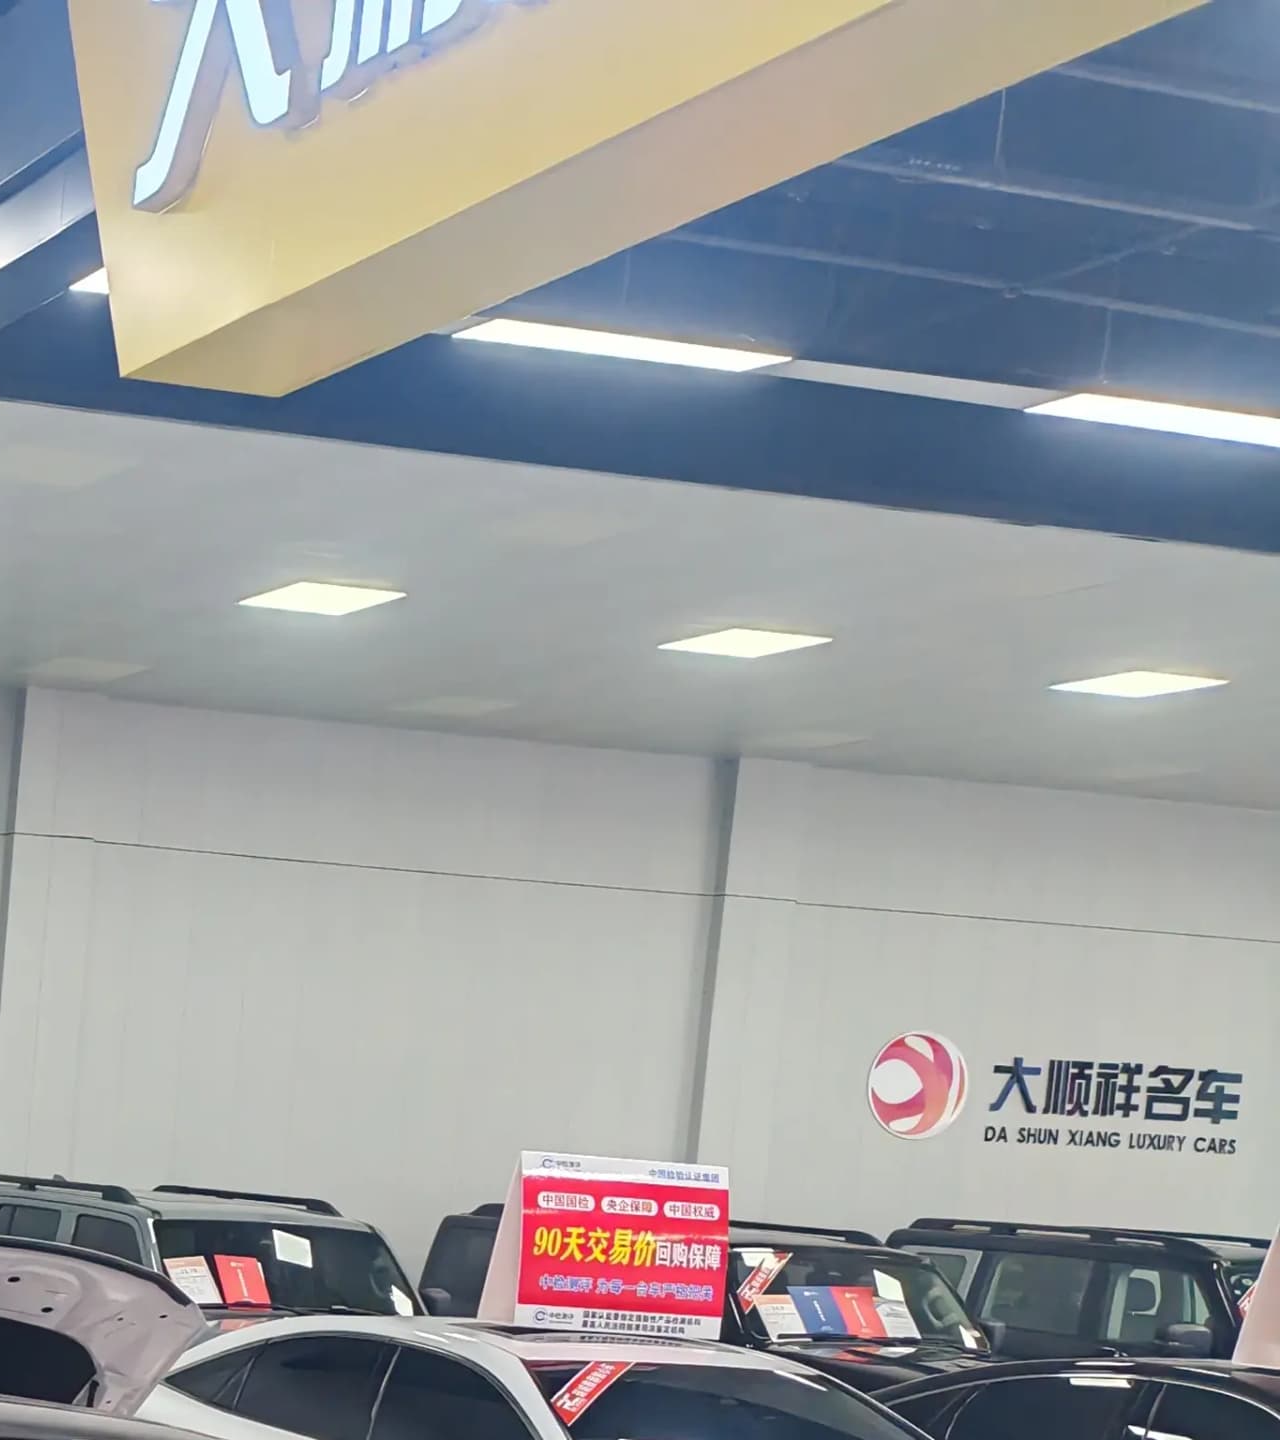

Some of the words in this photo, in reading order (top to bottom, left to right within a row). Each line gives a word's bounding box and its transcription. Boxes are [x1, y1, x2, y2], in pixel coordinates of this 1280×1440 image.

[988, 1056, 1243, 1125] 大顺祥名车
[983, 1125, 1009, 1143] DA
[1017, 1127, 1059, 1146] SHUN
[1067, 1129, 1121, 1149] XIANG
[1128, 1132, 1187, 1152] LUXURY
[1193, 1136, 1237, 1155] CARS
[542, 1194, 590, 1209] 中国国检
[607, 1198, 654, 1214] 央企保障
[668, 1203, 716, 1219] 中国权威
[533, 1226, 722, 1271] 90天交易价回购保障
